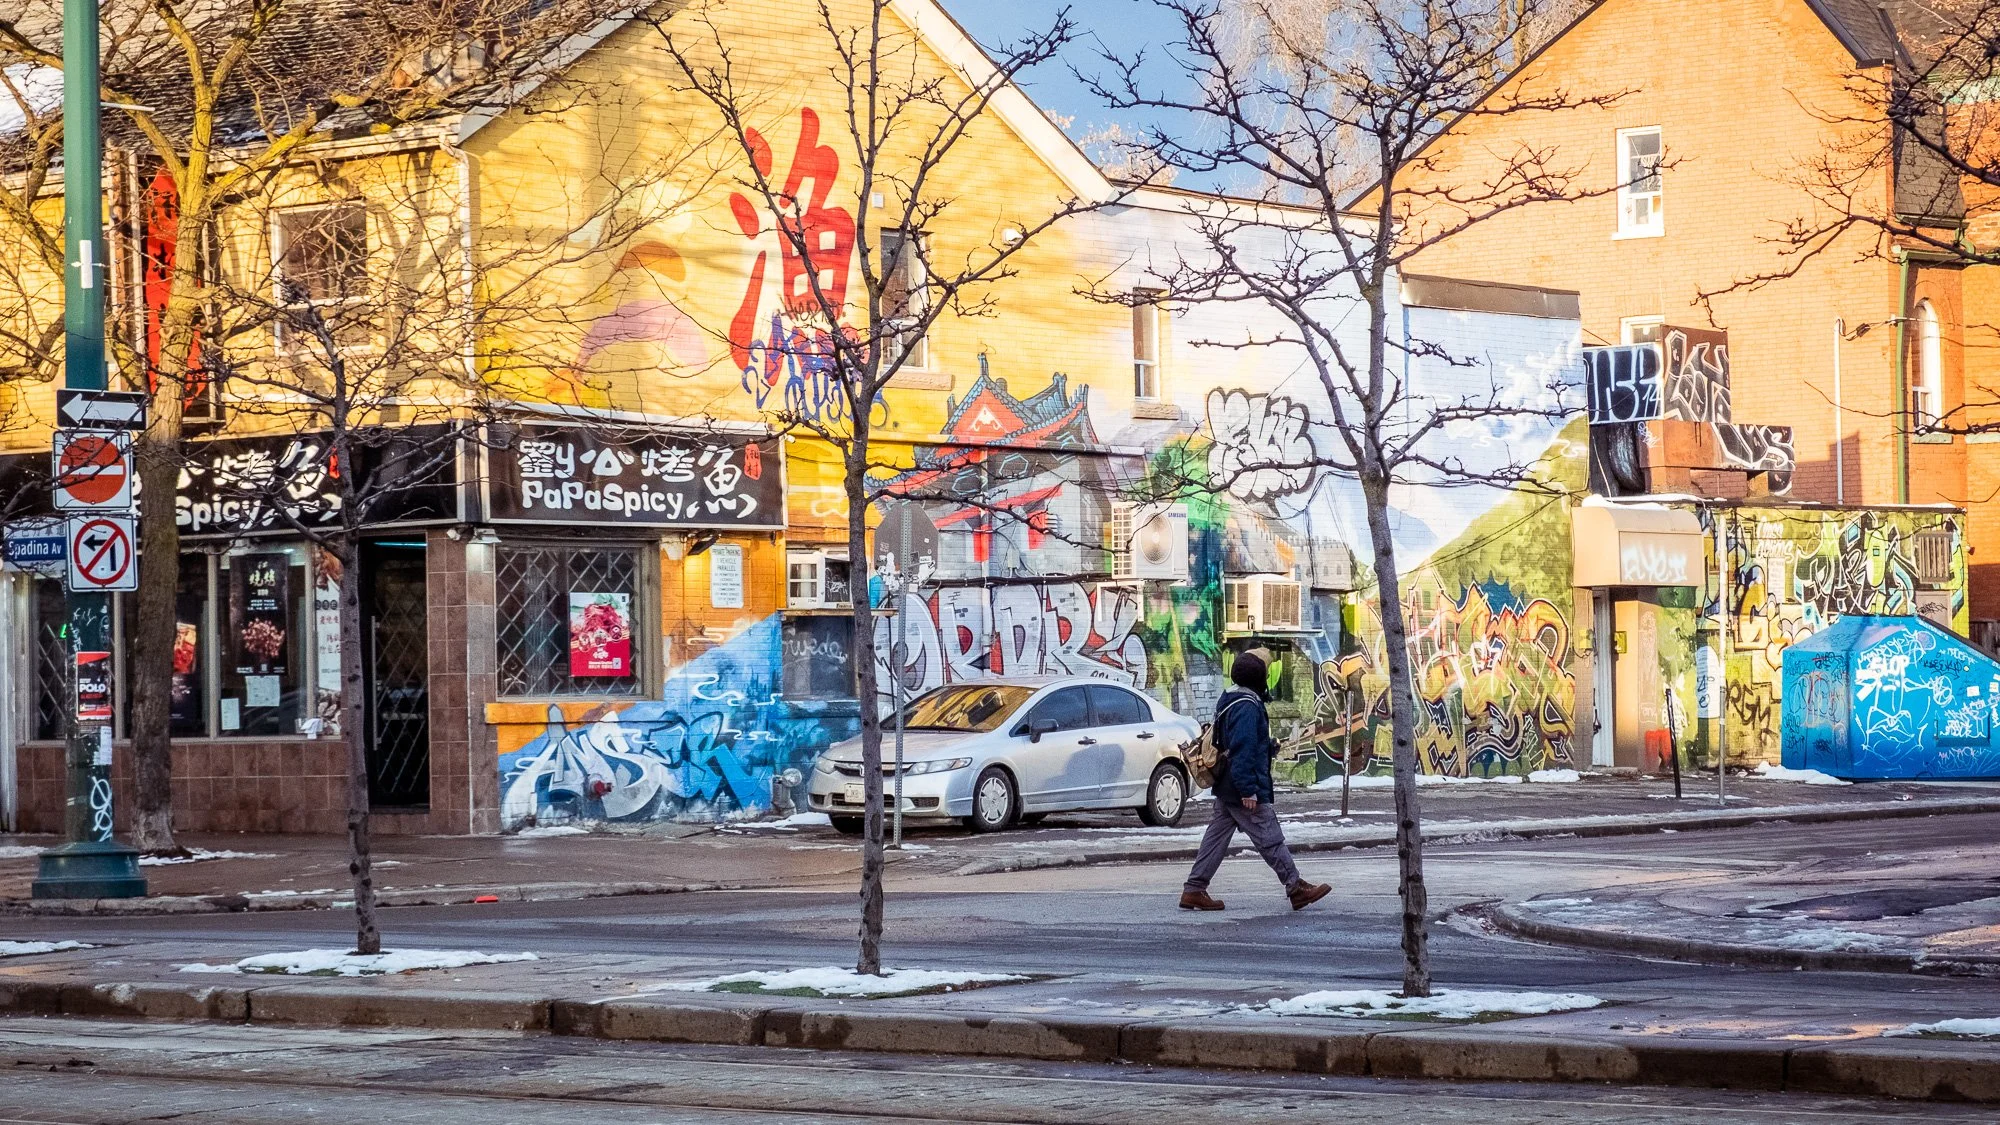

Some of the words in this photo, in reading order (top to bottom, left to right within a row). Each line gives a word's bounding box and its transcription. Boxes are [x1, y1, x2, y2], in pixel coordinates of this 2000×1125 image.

[521, 480, 683, 519] PaPaSpicy
[9, 540, 49, 559] Spadina
[52, 543, 62, 555] Av
[79, 683, 106, 693] POLO
